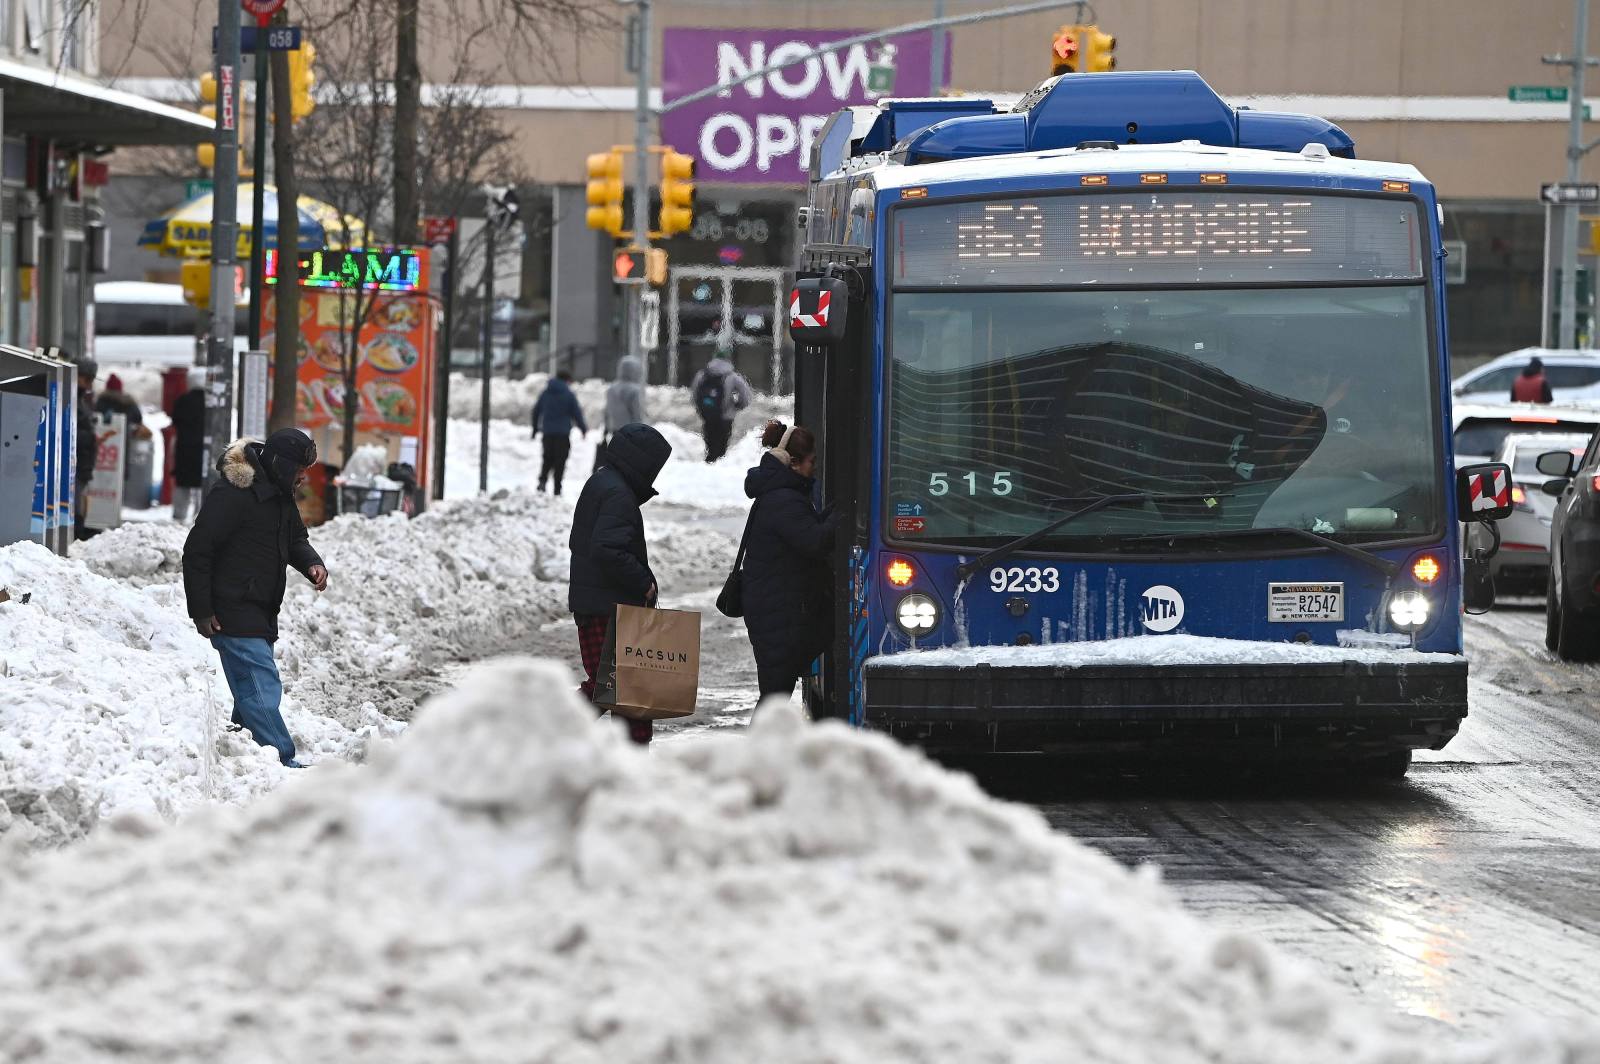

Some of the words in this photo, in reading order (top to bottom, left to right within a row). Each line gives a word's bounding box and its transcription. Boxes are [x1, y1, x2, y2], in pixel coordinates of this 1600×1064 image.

[269, 29, 293, 48] Q58
[717, 41, 897, 99] NOW
[174, 225, 253, 241] SABT
[1079, 202, 1312, 255] WOODSIDE
[989, 567, 1060, 593] 9233
[1142, 596, 1177, 623] MTA
[1308, 595, 1337, 613] 2542
[625, 646, 687, 663] PACSUN
